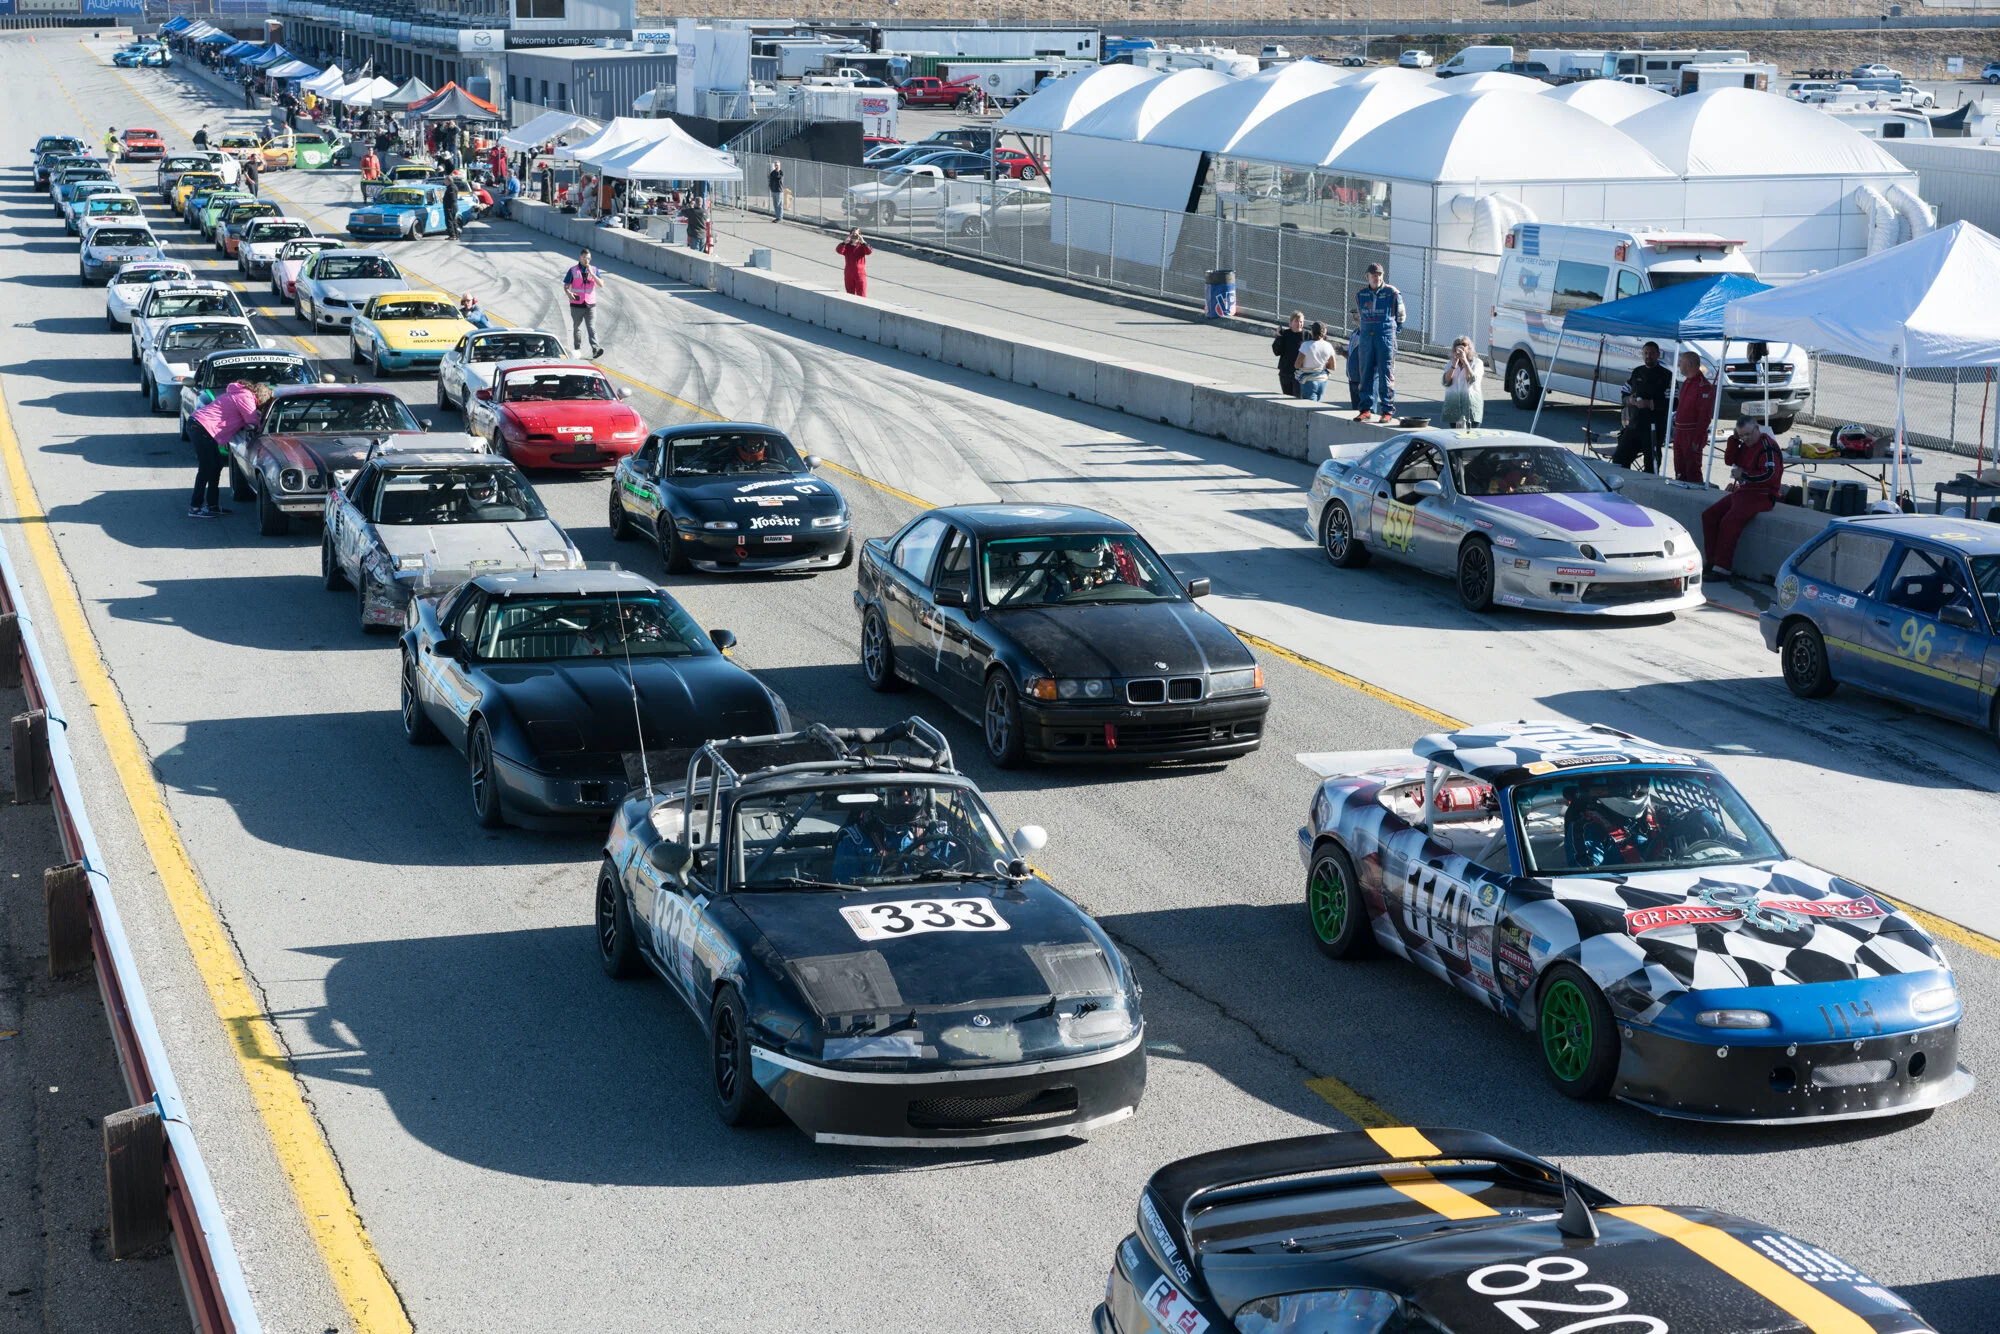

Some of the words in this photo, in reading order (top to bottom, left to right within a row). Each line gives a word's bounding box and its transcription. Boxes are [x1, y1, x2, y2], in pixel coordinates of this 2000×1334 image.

[511, 36, 544, 45] Welcome
[546, 37, 556, 45] to
[557, 36, 580, 47] Camp
[214, 357, 241, 366] GOOD
[269, 356, 302, 365] RACING
[750, 515, 801, 530] Hoosier
[1557, 567, 1595, 576] PYROTECT
[931, 607, 946, 672] 9
[1897, 617, 1936, 663] 96
[870, 900, 997, 934] 333
[1408, 867, 1458, 951] 114
[1631, 908, 1736, 928] GRAPHIC
[1818, 1000, 1882, 1037] 114
[1169, 1251, 1192, 1284] LABS
